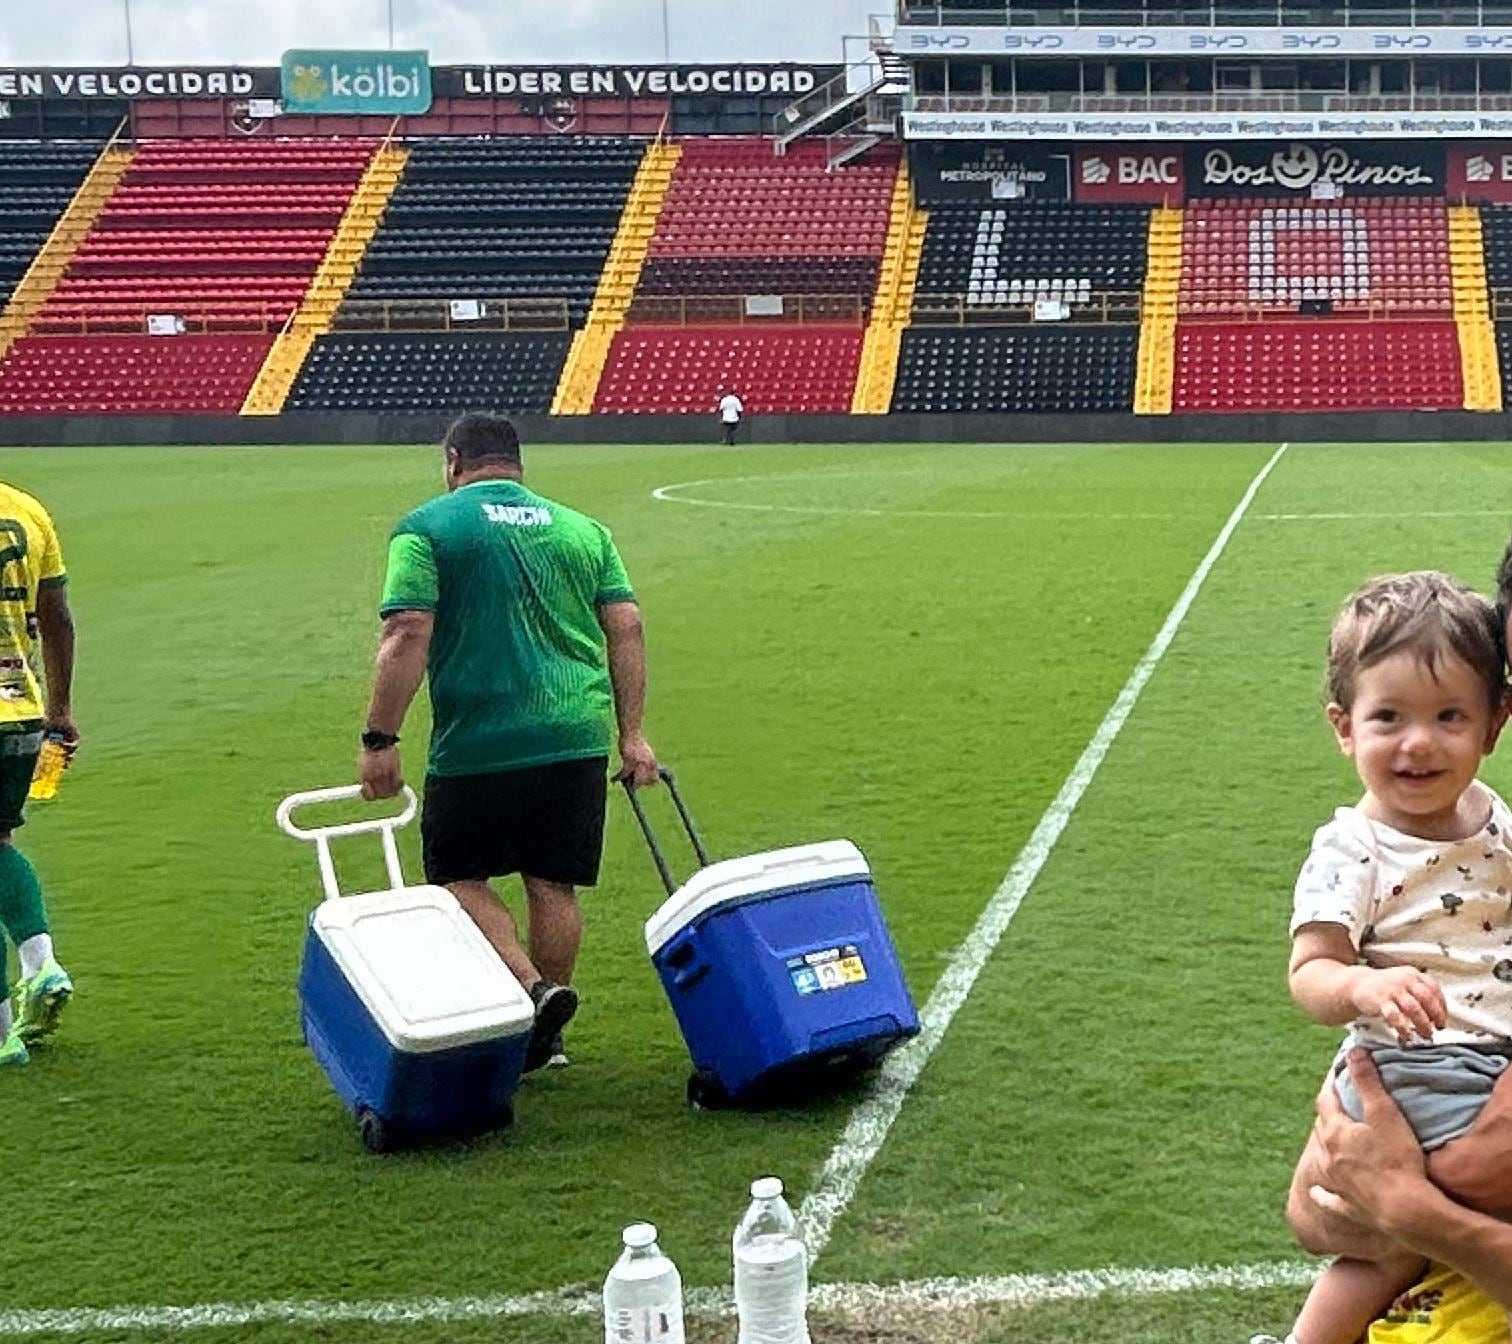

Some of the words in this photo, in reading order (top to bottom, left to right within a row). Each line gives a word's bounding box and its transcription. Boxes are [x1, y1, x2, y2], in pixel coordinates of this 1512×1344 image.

[910, 34, 970, 49] BYD
[1004, 34, 1063, 49] BYD
[1097, 34, 1156, 49] BYD
[1189, 34, 1248, 49] BYD
[1282, 34, 1340, 48] BYD
[1373, 34, 1431, 48] BYD
[0, 74, 43, 95] EN
[53, 72, 252, 95] VELOCIDAD
[331, 63, 420, 98] kölbi
[570, 71, 614, 94] EN
[623, 70, 815, 94] VELOCIDAD
[941, 170, 1046, 182] METROPOLITANO
[1118, 157, 1178, 184] BAC
[1204, 148, 1274, 185] Dos
[1318, 147, 1433, 185] Pinos
[967, 210, 1090, 303] L
